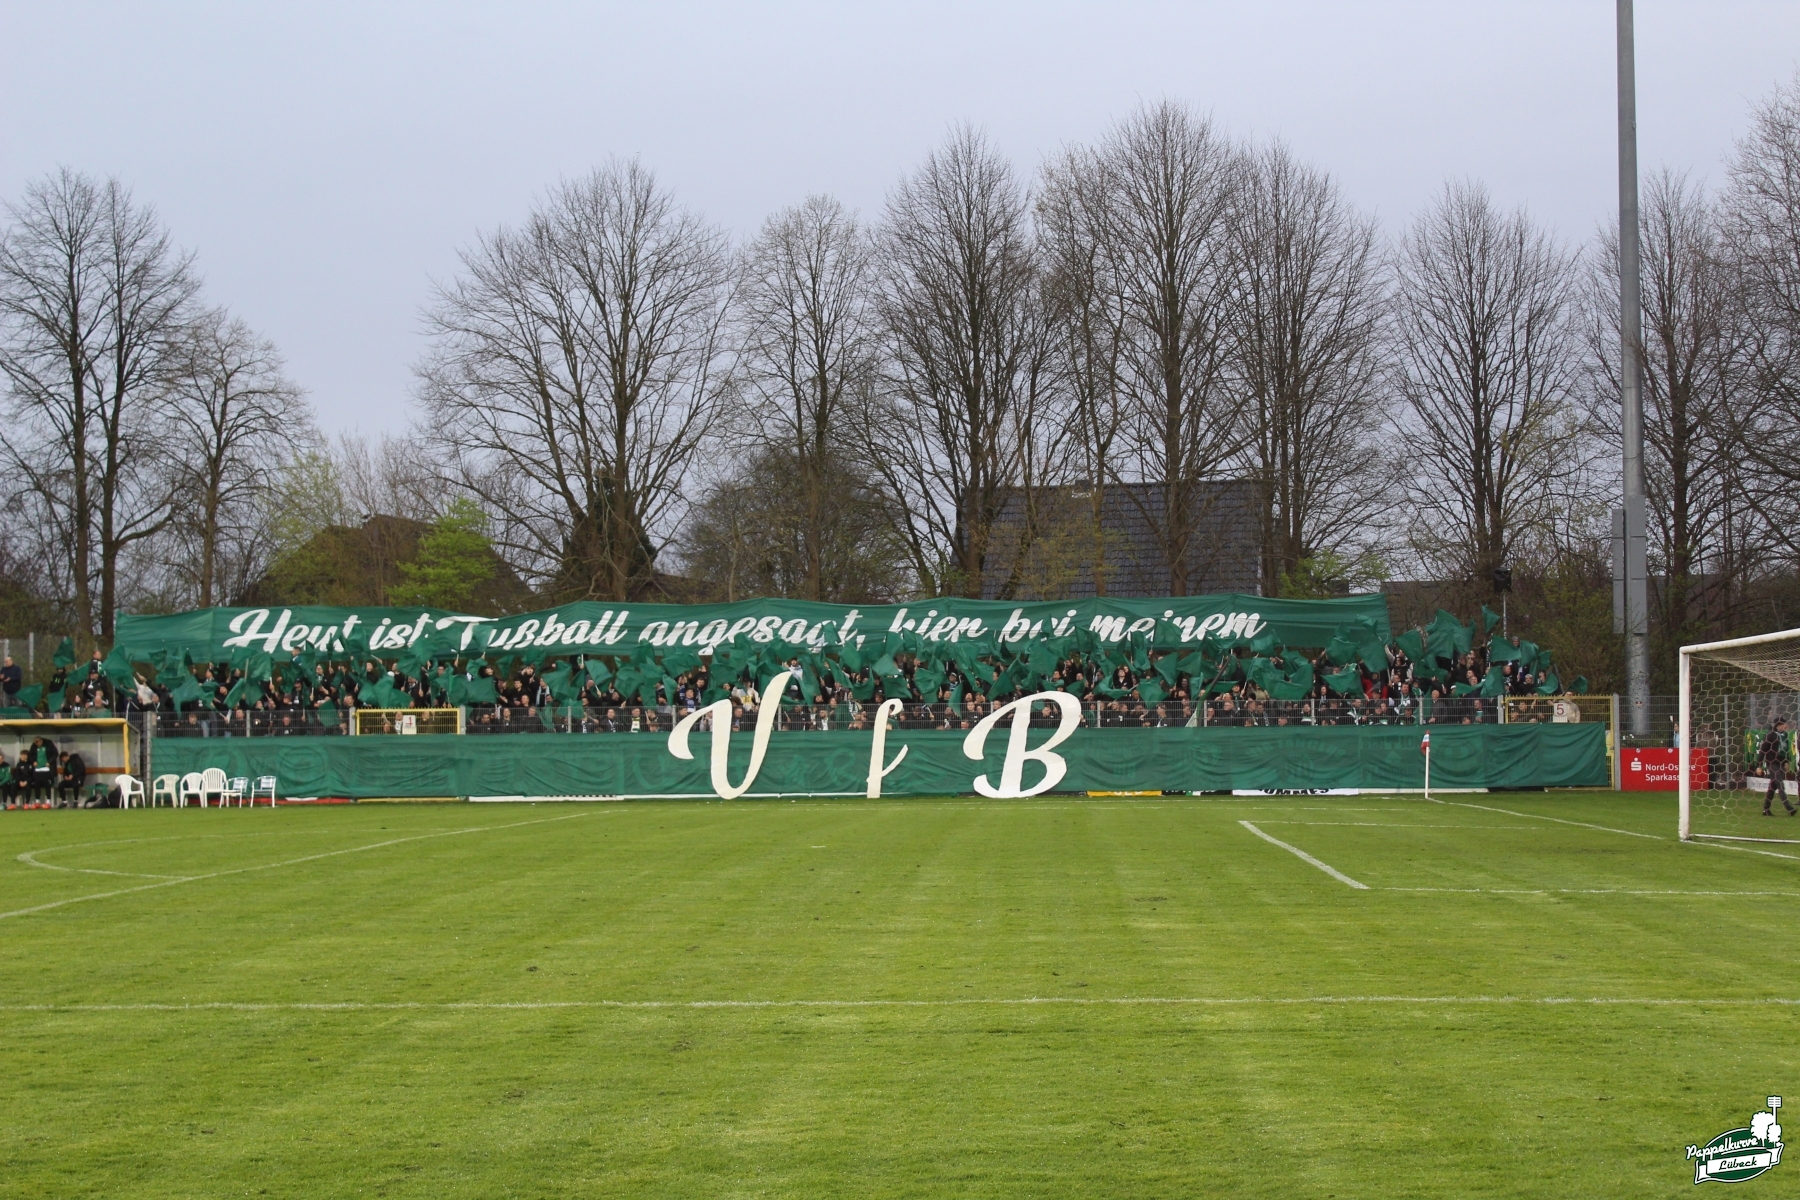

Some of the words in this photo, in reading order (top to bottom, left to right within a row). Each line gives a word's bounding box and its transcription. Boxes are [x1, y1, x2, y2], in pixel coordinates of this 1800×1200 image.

[1556, 703, 1565, 716] 5
[1645, 763, 1696, 771] Nord-Ose
[1645, 773, 1680, 782] Sparkass
